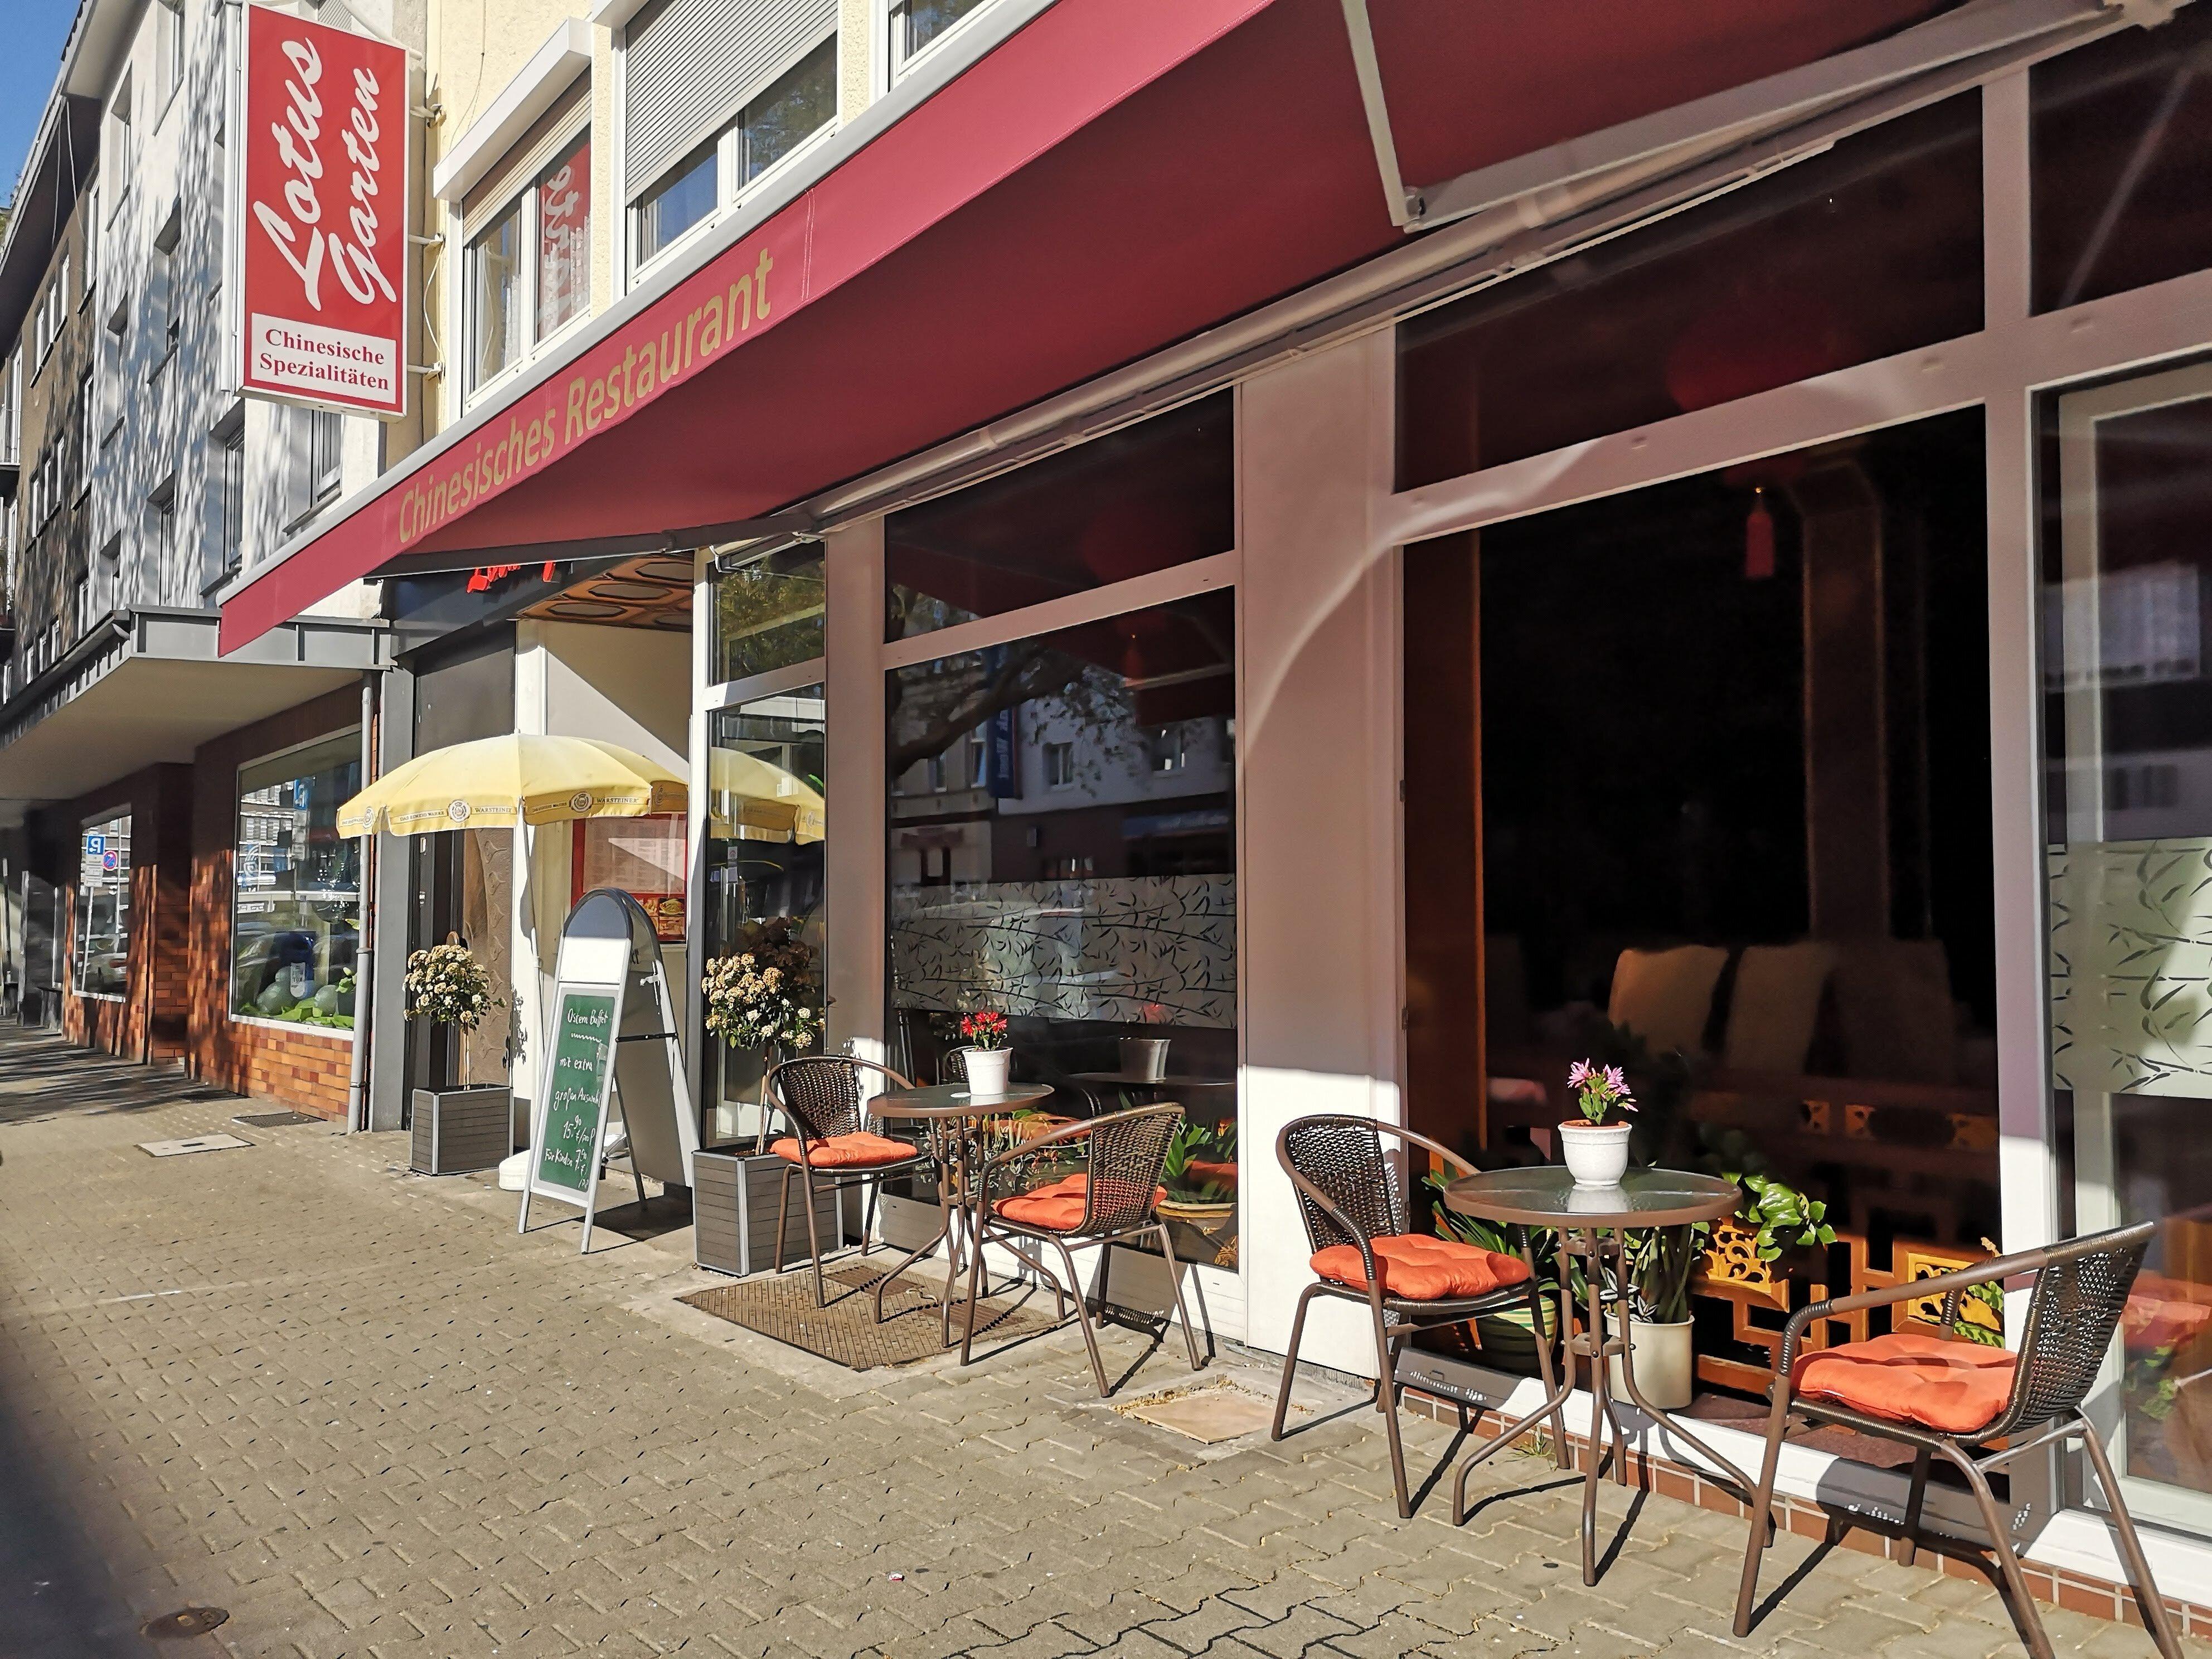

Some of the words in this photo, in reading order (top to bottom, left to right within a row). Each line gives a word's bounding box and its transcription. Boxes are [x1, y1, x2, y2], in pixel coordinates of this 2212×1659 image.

[253, 37, 324, 312] Lotus
[329, 67, 397, 304] Garten
[259, 352, 389, 390] Spezialitäten
[265, 328, 385, 366] Chinesische
[399, 407, 556, 544] Chinesisches
[564, 248, 774, 445] Restaurant
[574, 1058, 593, 1072] extra
